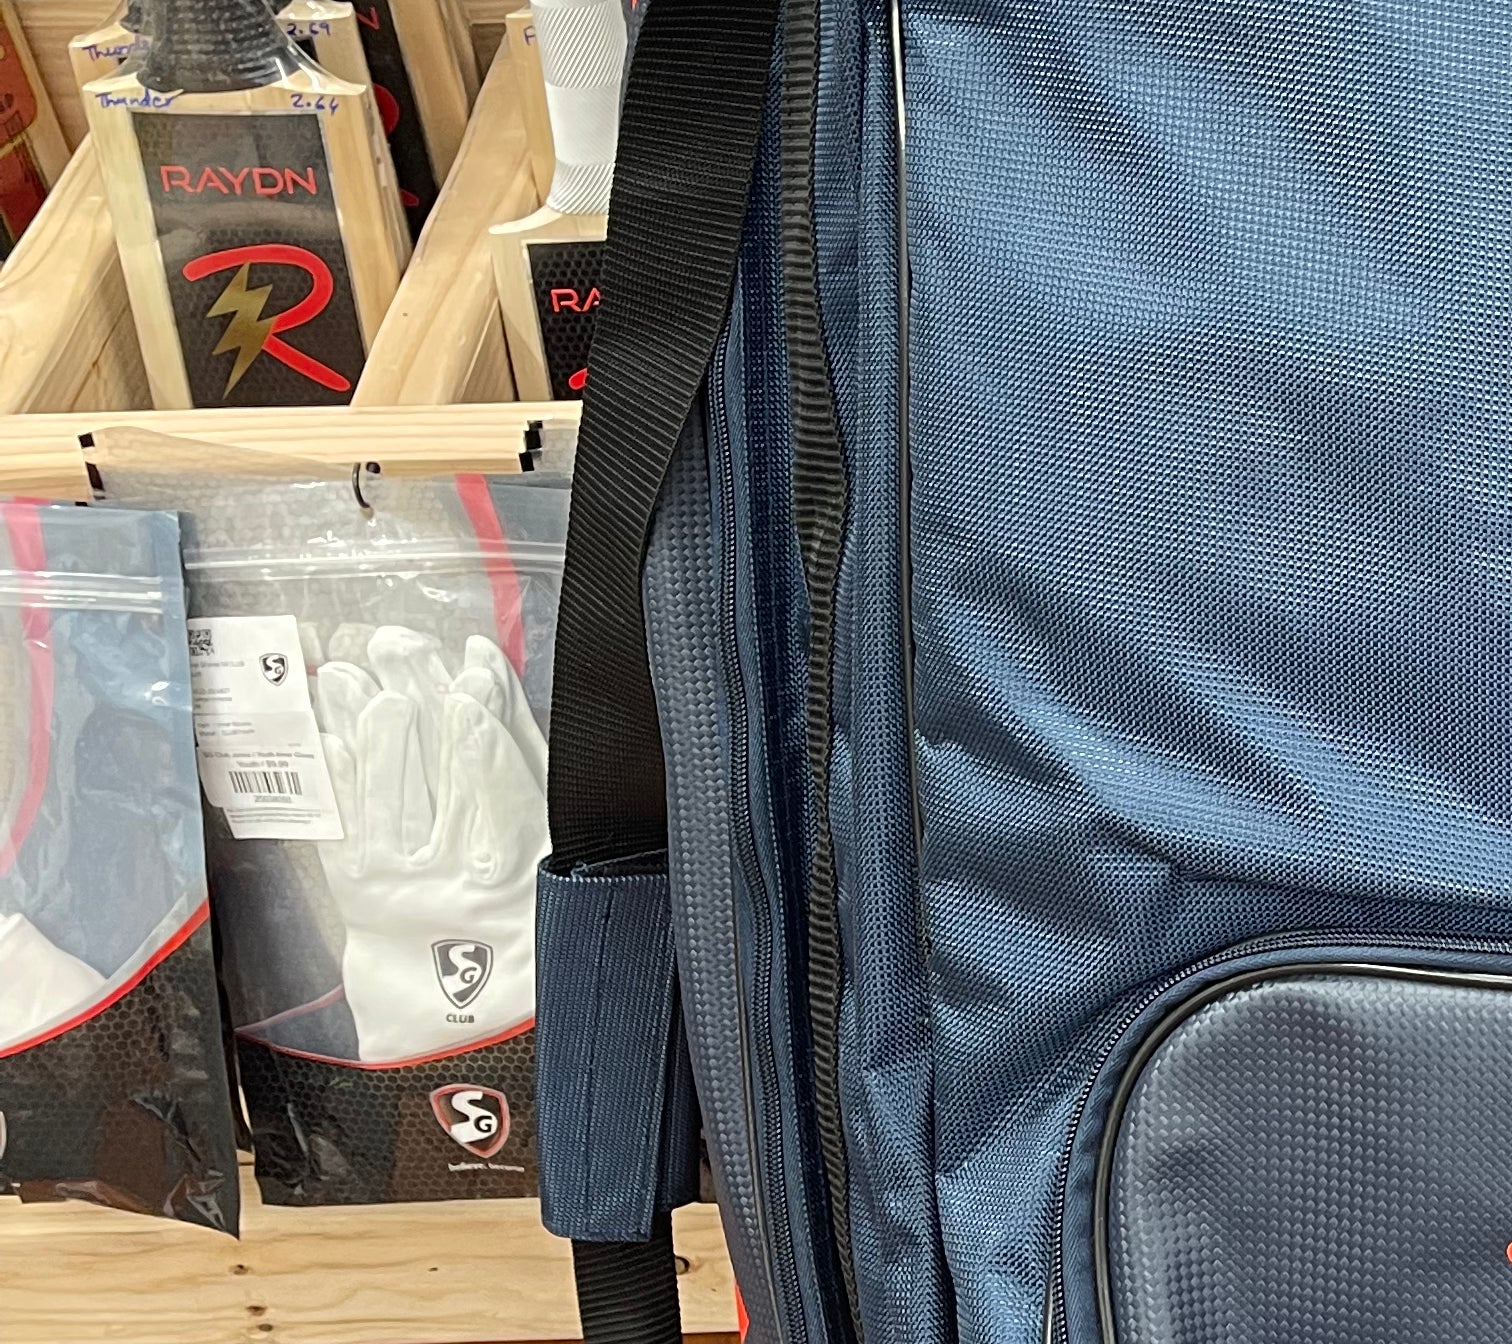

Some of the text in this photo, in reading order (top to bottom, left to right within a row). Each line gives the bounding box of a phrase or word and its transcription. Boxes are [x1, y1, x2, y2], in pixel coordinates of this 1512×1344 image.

[160, 165, 318, 196] RAYDN
[446, 1013, 475, 1024] CLUB
[448, 1088, 500, 1145] SG
